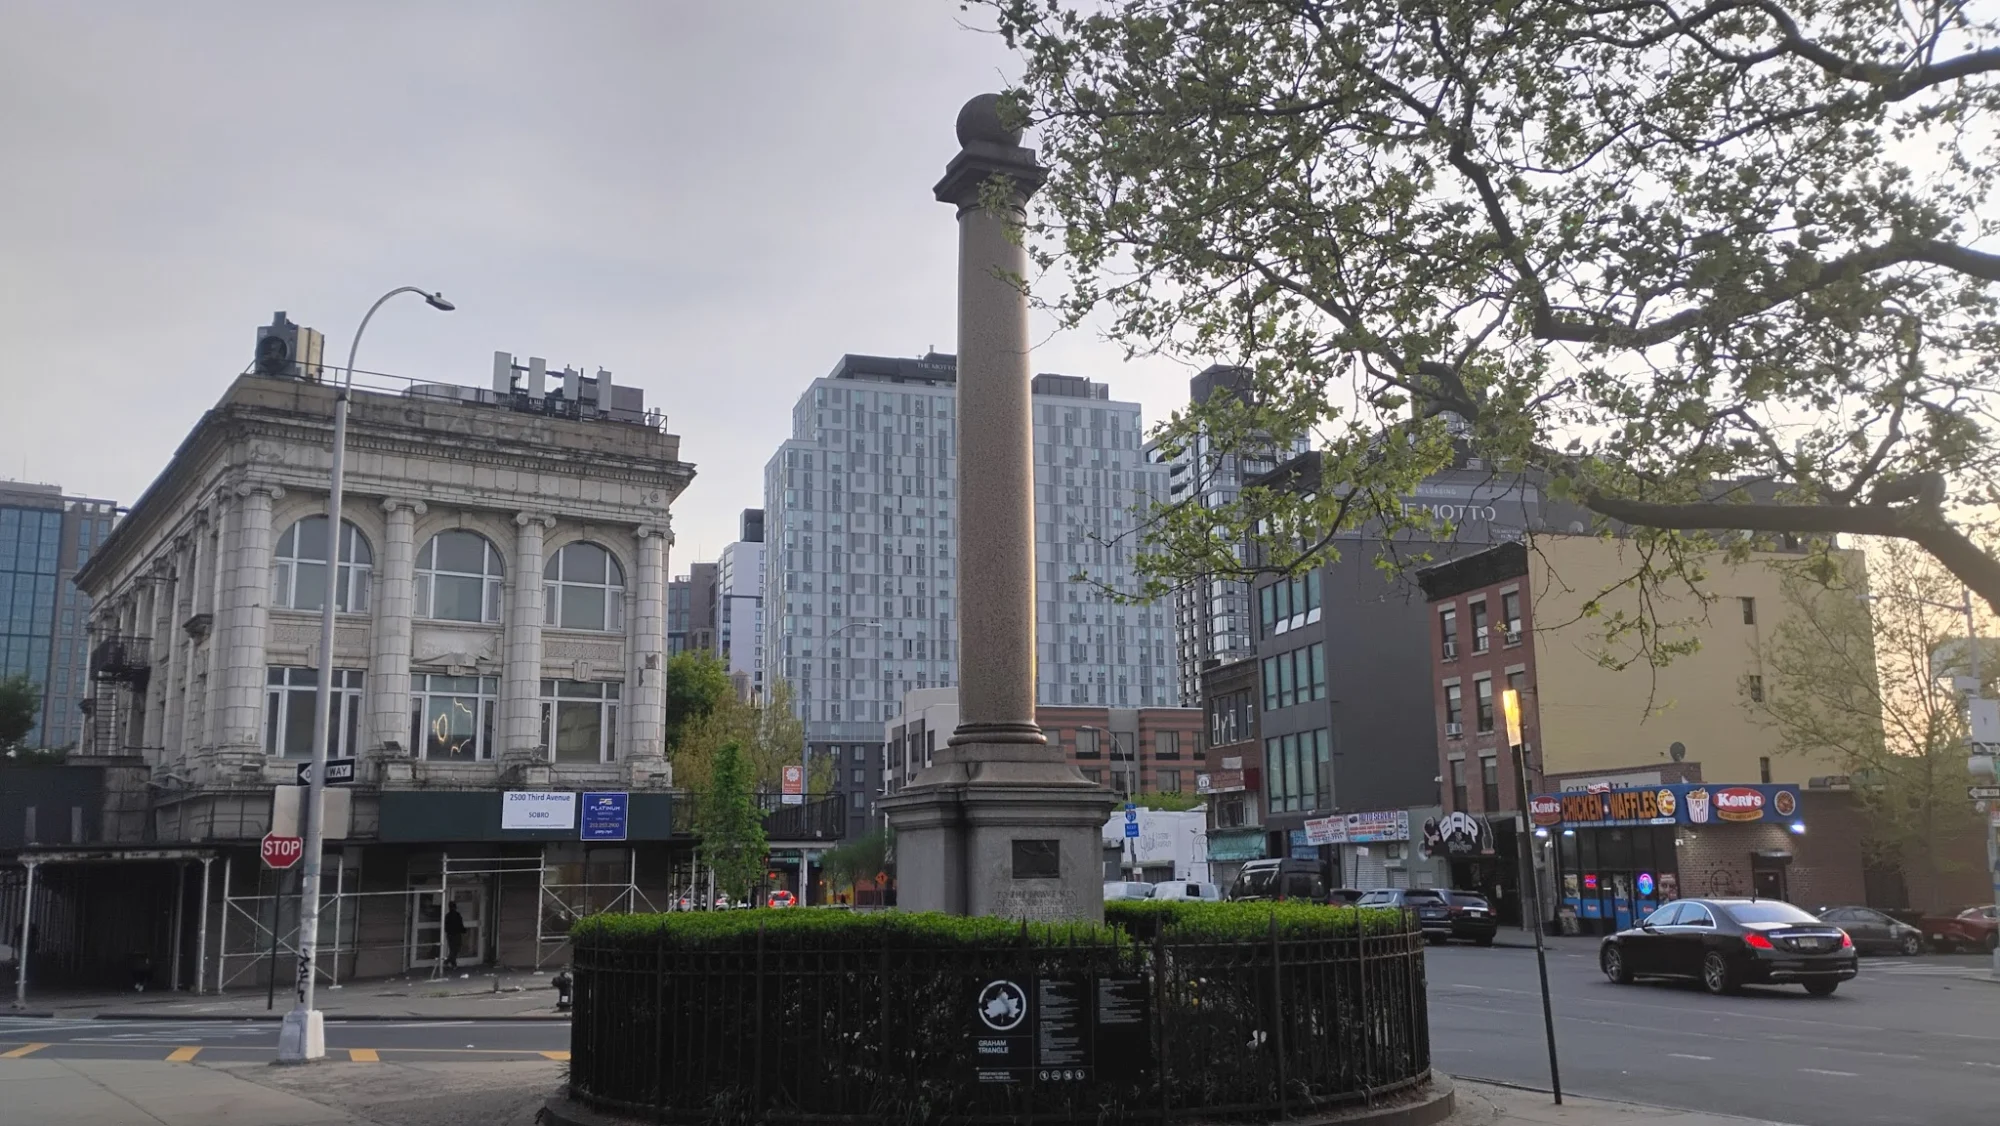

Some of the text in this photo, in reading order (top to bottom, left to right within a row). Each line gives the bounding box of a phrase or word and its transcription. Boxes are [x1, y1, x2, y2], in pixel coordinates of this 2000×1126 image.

[1422, 503, 1496, 522] MOTTO
[329, 766, 347, 777] WAY
[510, 793, 526, 801] 2500
[527, 793, 545, 801] Third
[1562, 794, 1604, 821] CHICKEN
[1609, 790, 1658, 819] WAFFLES
[528, 811, 550, 819] SOBRO
[1439, 811, 1479, 843] BAR
[263, 840, 300, 856] STOP
[978, 1039, 1007, 1047] GRAHAM
[978, 1046, 1009, 1054] TRIANGLE
